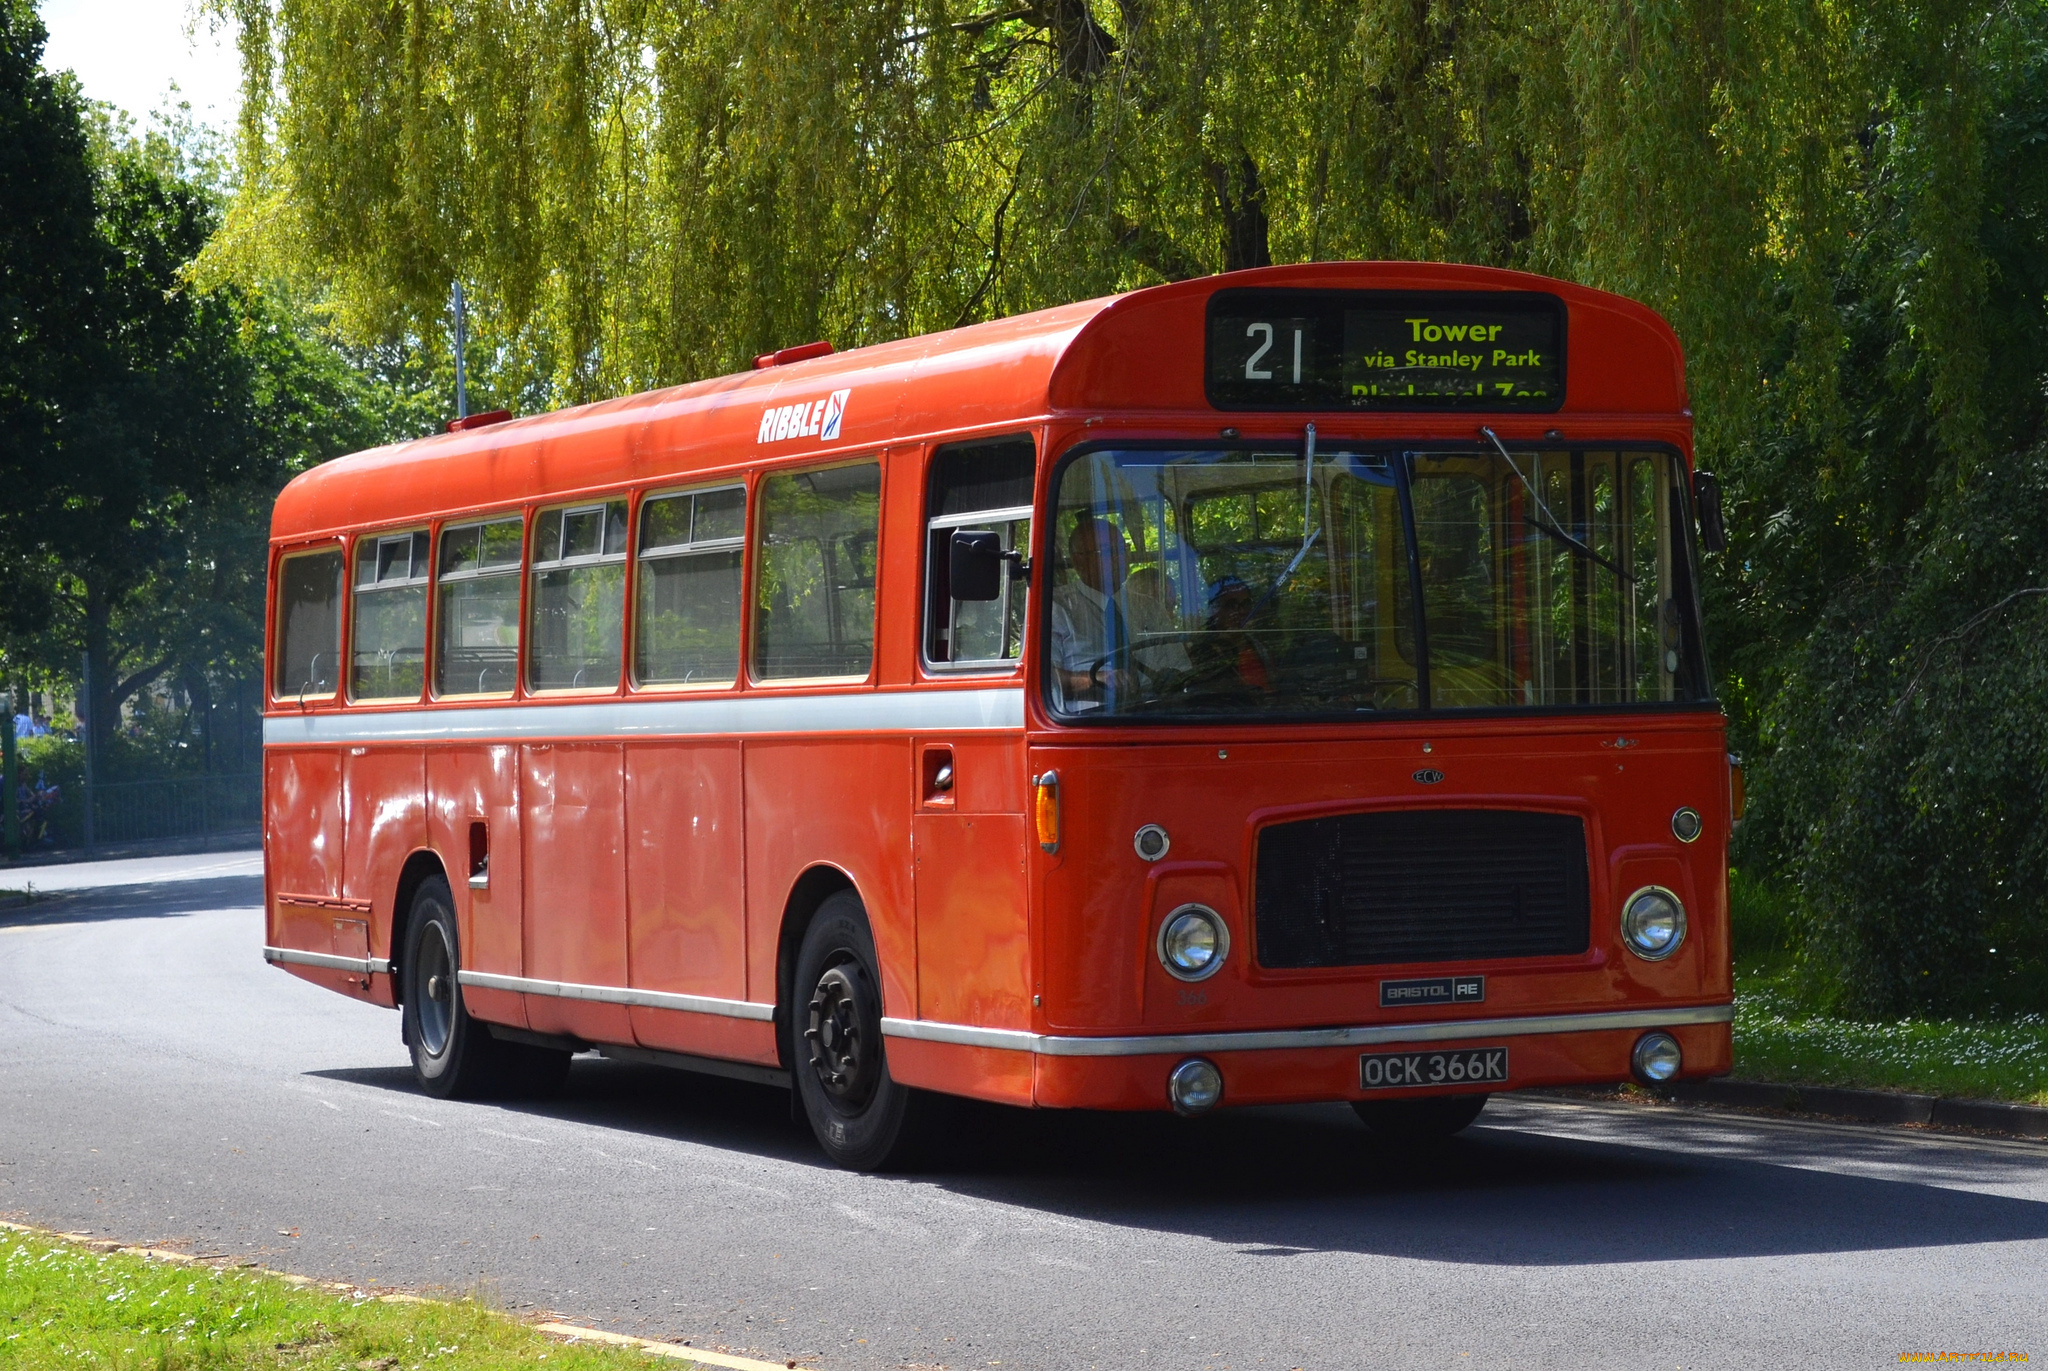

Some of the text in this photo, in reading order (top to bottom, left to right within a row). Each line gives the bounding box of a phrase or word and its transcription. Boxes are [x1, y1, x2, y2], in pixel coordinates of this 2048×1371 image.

[1405, 318, 1502, 342] Tower
[1245, 322, 1302, 384] 21
[1364, 350, 1542, 371] via Stanley Park
[757, 399, 826, 444] RIBBLE
[1416, 770, 1442, 783] ECW
[1387, 986, 1449, 999] BRISTOL
[1364, 1052, 1503, 1085] OCK 366K
